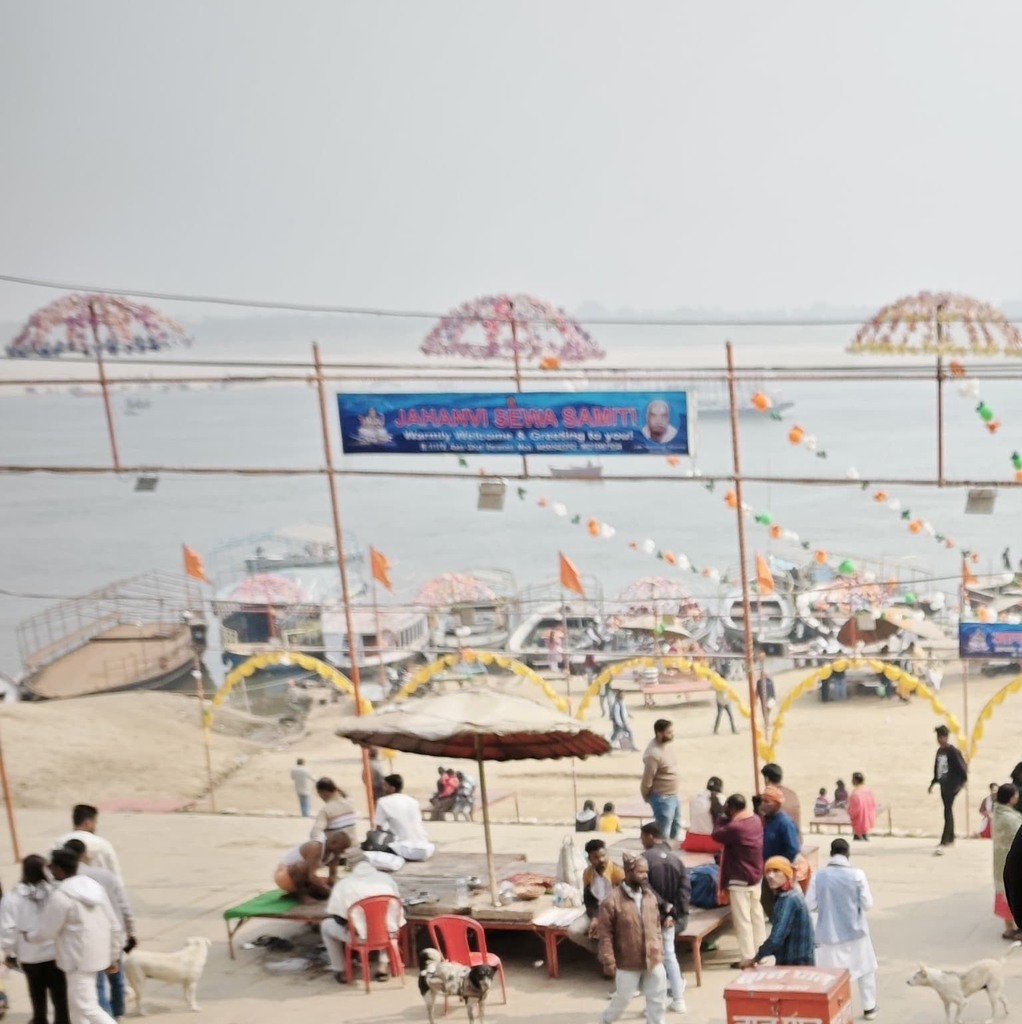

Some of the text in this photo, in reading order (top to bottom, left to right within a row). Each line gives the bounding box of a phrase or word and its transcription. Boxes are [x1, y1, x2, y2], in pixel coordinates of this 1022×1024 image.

[395, 406, 638, 429] JAHANVI SEWA SAMITI
